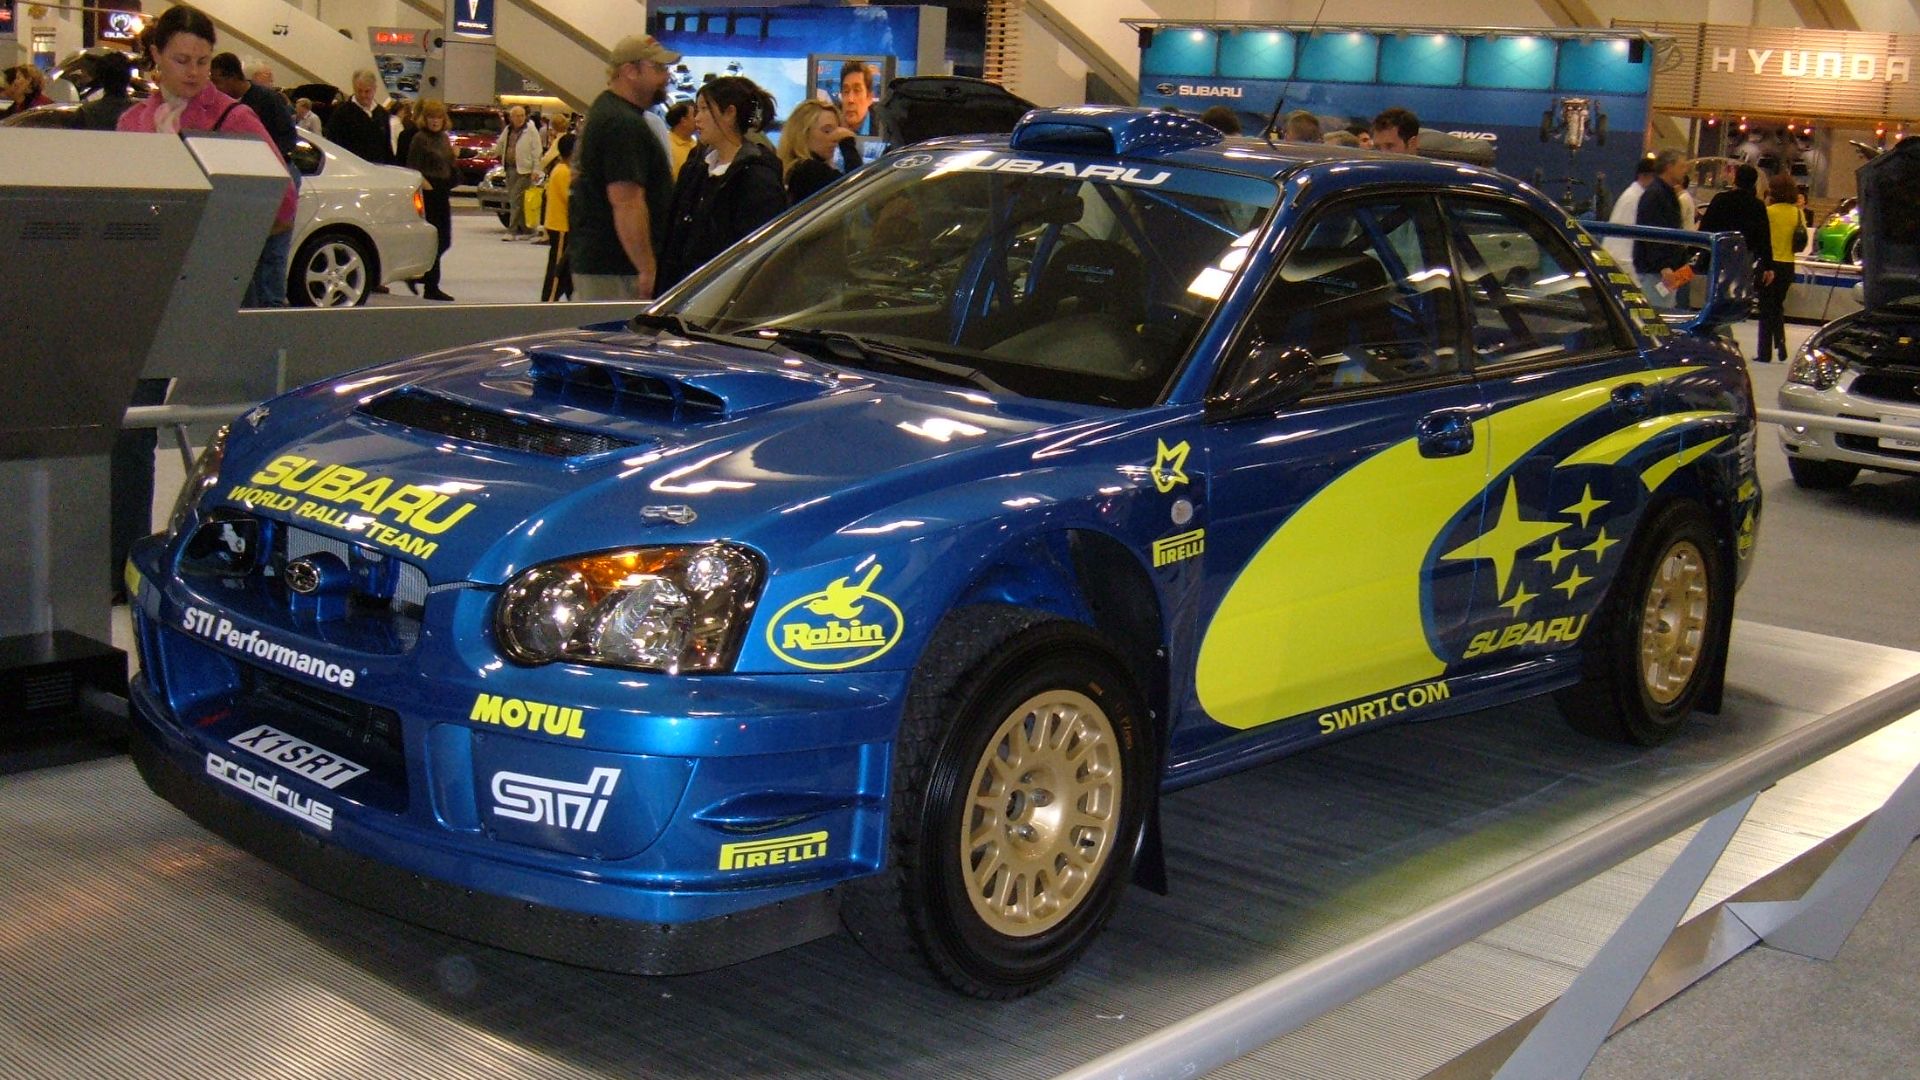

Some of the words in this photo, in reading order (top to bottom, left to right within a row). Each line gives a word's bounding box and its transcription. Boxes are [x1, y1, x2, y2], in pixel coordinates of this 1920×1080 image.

[1178, 84, 1243, 98] SUBARU
[251, 455, 477, 535] SUBARU
[227, 486, 298, 512] WORLD
[296, 500, 374, 533] RALL
[365, 520, 438, 560] TEAM
[1152, 528, 1205, 568] PIRELLI
[183, 606, 216, 638] STI
[214, 618, 356, 688] Performance
[1462, 614, 1589, 660] SUBARU
[469, 692, 586, 739] MOTUL
[1318, 680, 1450, 735] SWRT.COM
[239, 728, 359, 781] X1SRT
[206, 751, 334, 831] prodrive
[718, 830, 829, 871] PIRELLI
